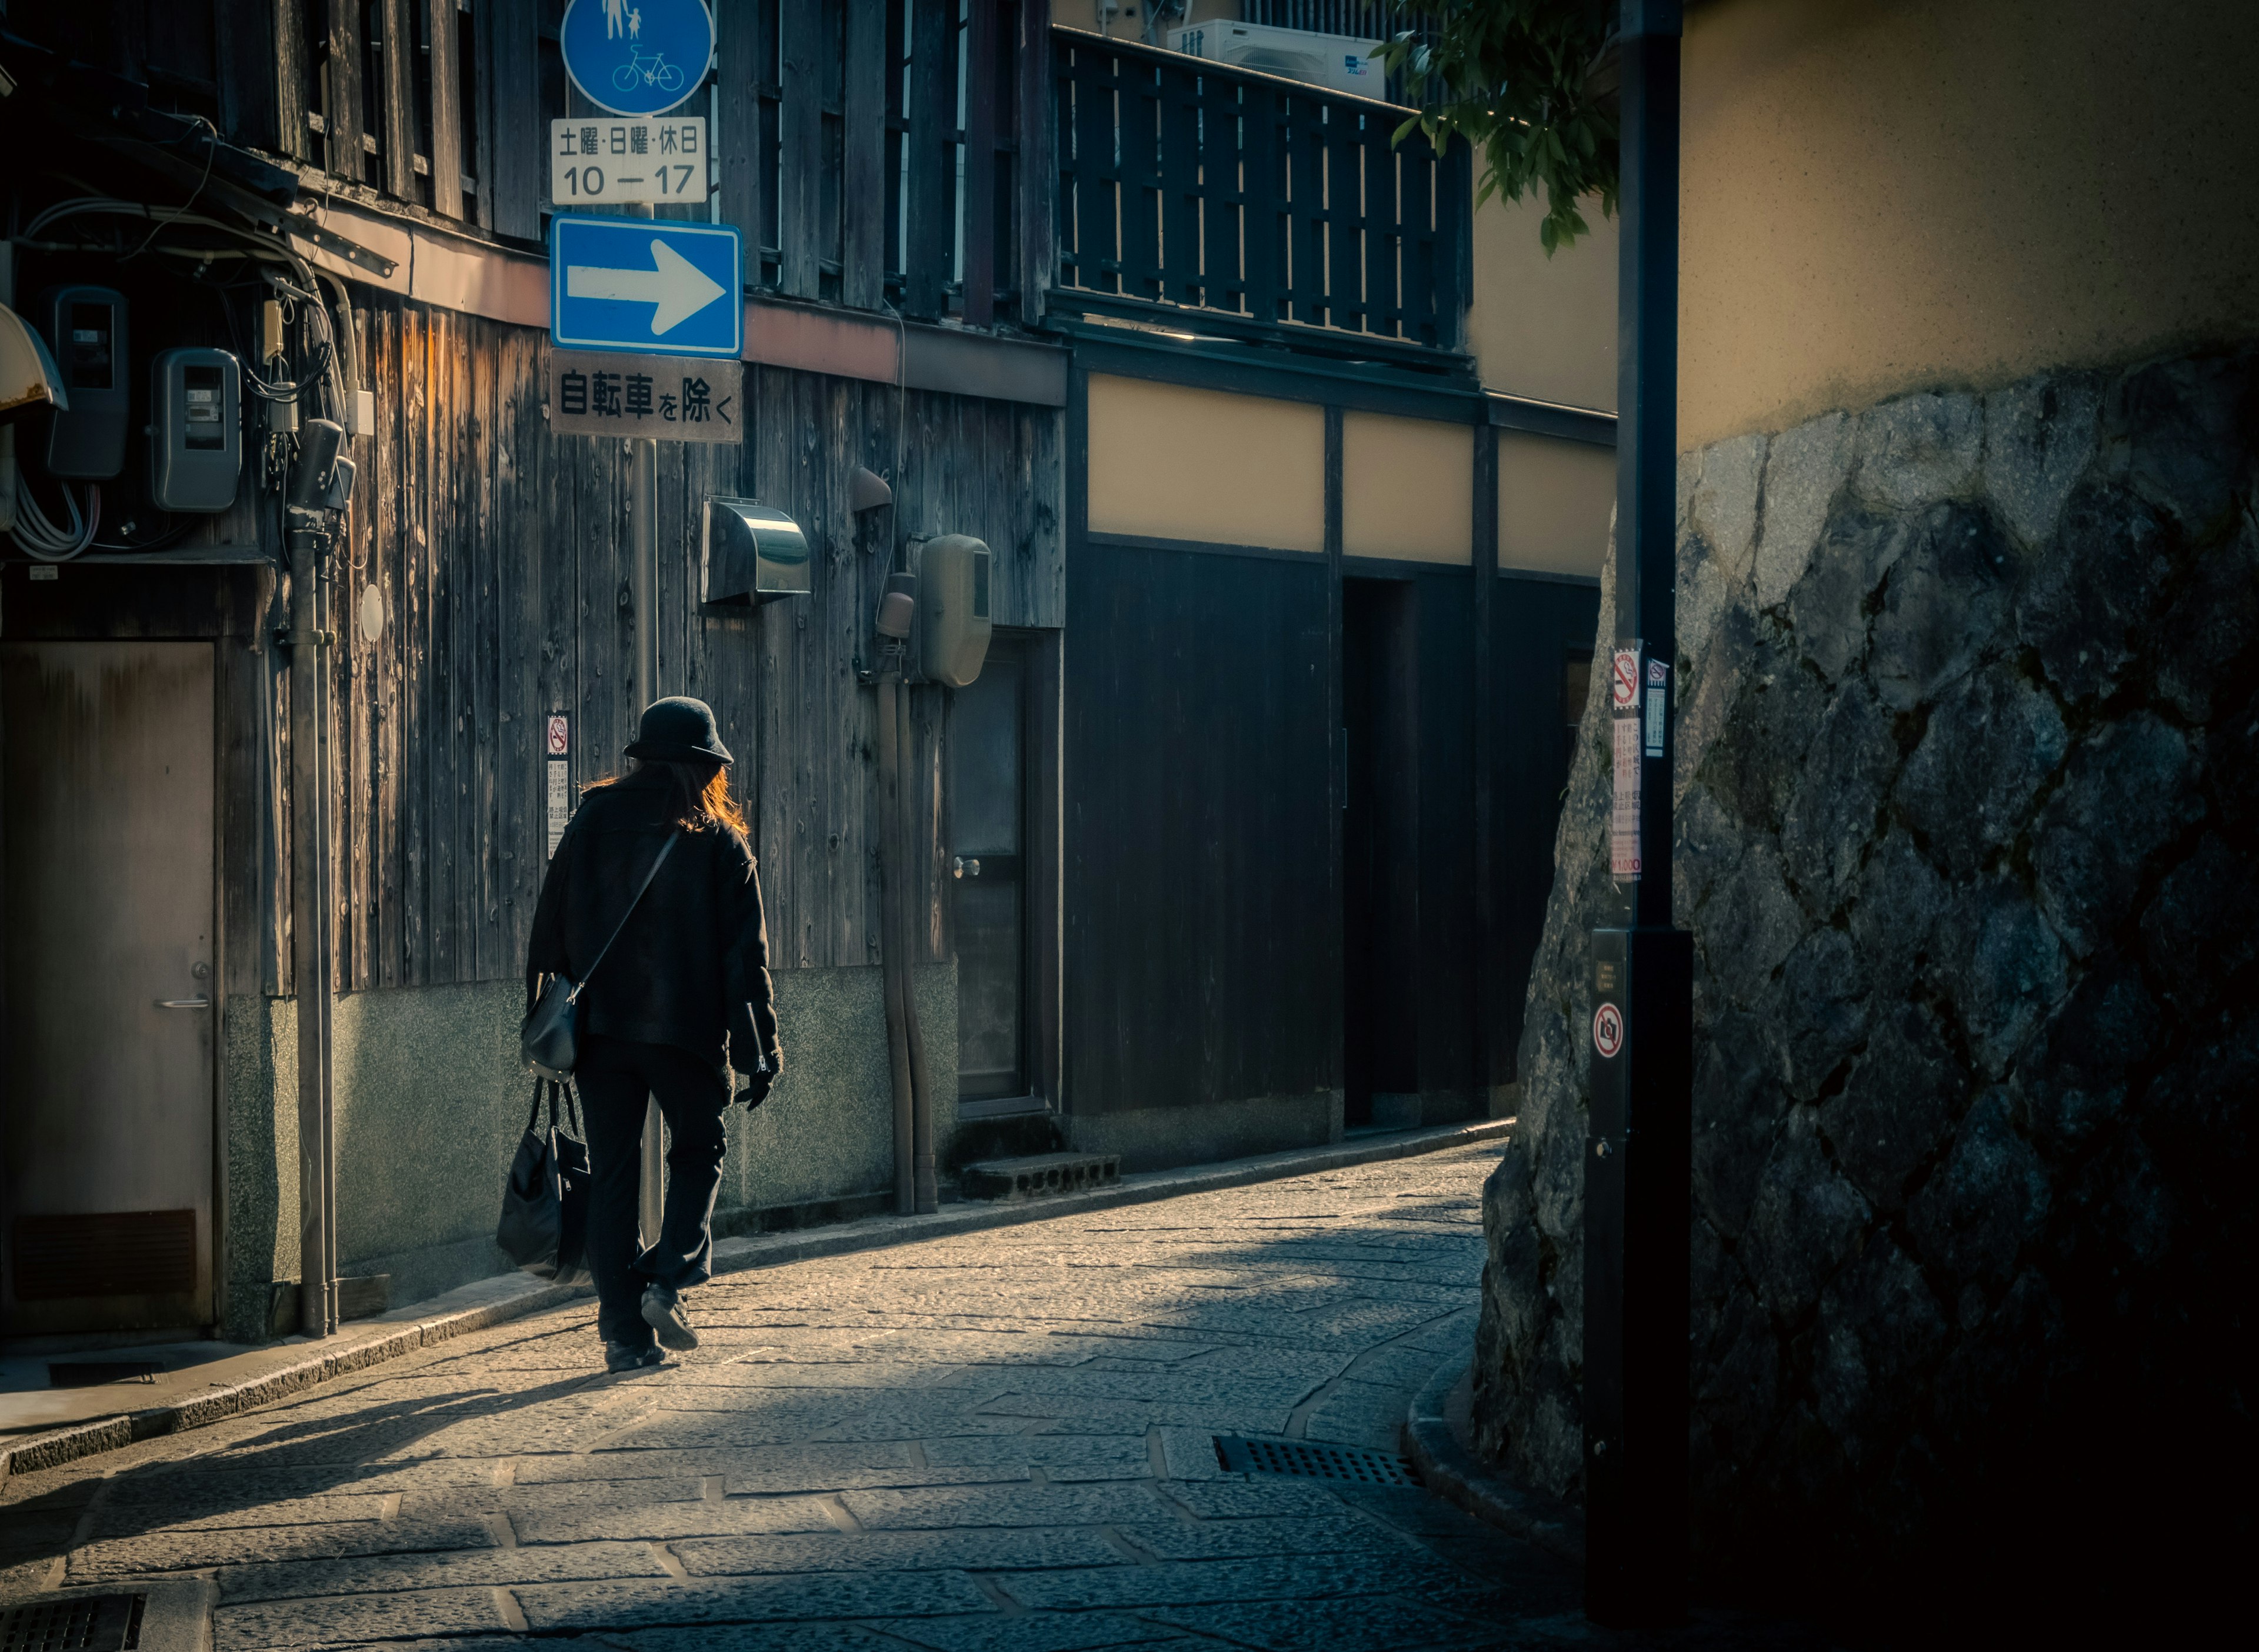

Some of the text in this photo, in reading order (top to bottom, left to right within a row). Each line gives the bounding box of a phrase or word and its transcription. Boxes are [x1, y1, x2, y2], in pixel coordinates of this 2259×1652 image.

[559, 125, 697, 155] 土曜・日曜・休日
[561, 369, 732, 424] 自転車を除く
